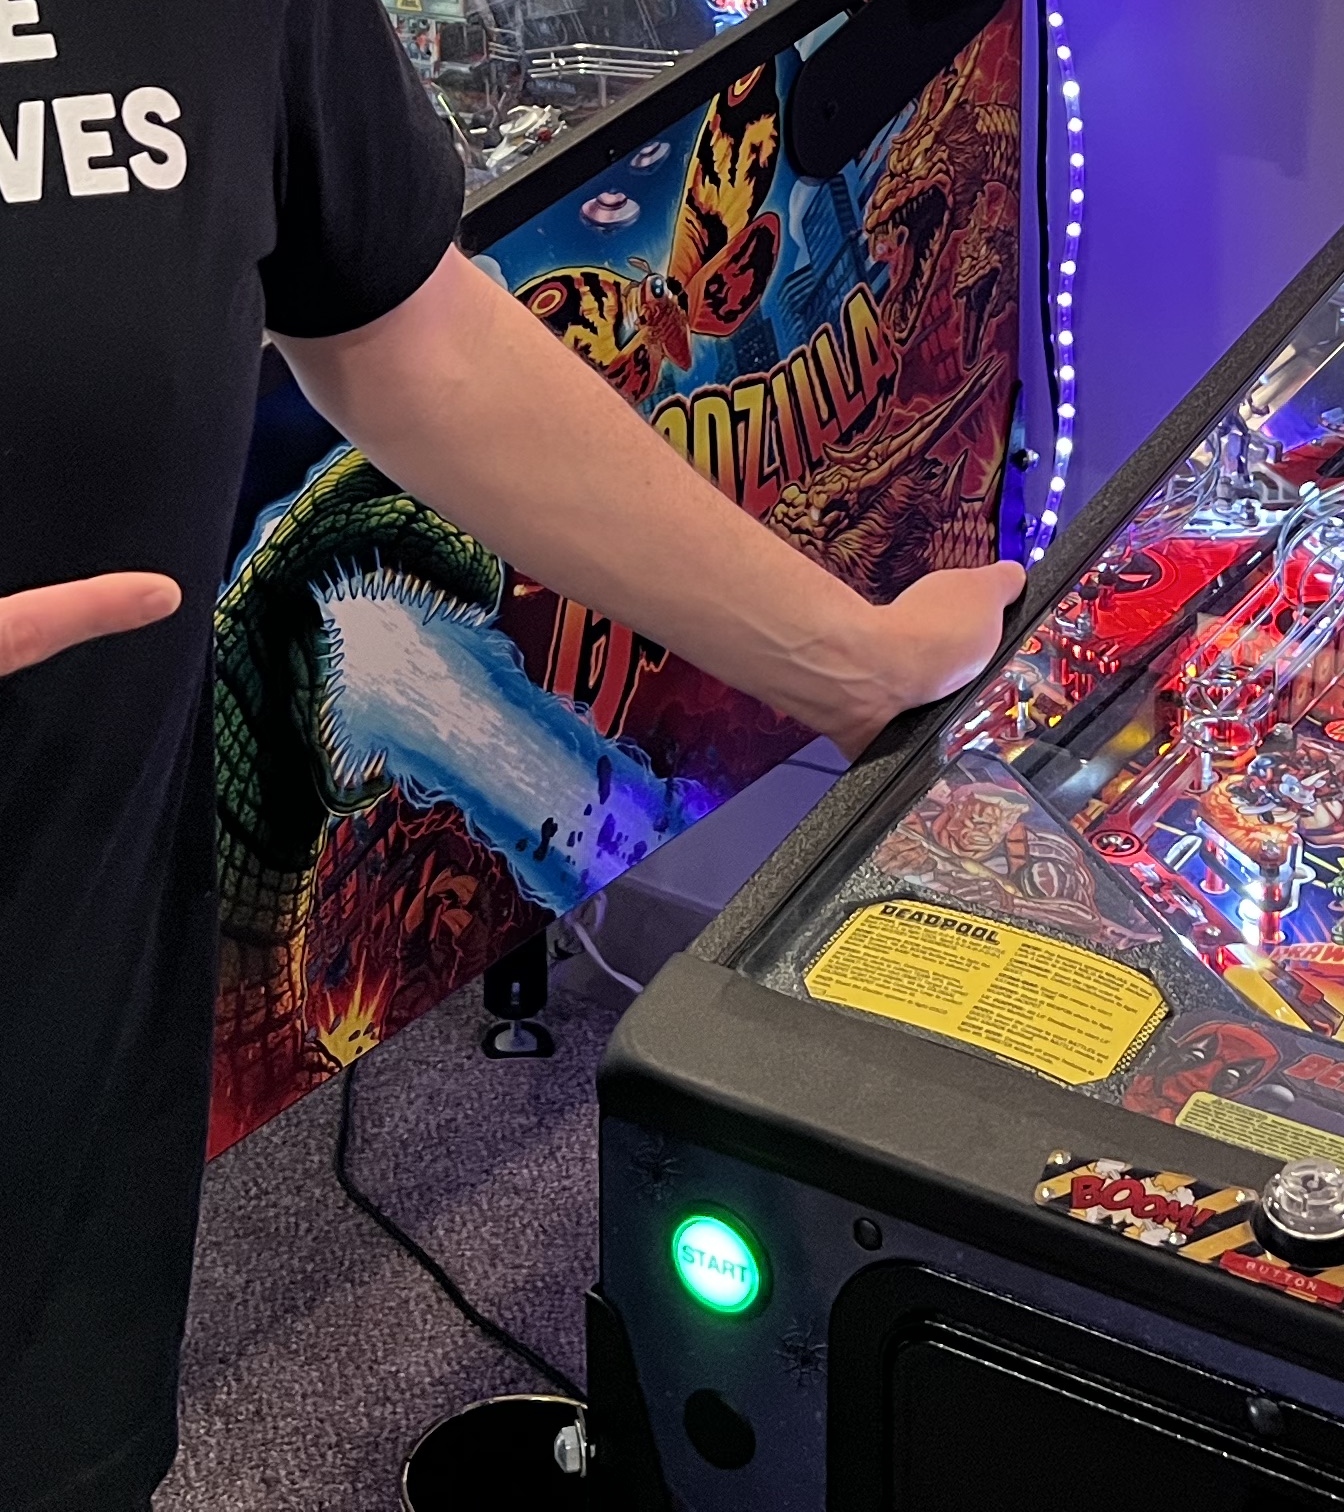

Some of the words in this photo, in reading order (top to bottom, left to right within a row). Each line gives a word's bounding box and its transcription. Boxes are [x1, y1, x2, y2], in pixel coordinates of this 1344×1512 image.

[655, 291, 896, 523] DZILLA
[879, 904, 1001, 946] DEADPOOL
[1071, 1174, 1217, 1236] BOOM!
[682, 1245, 747, 1283] START
[1245, 1260, 1318, 1292] BUTTON
